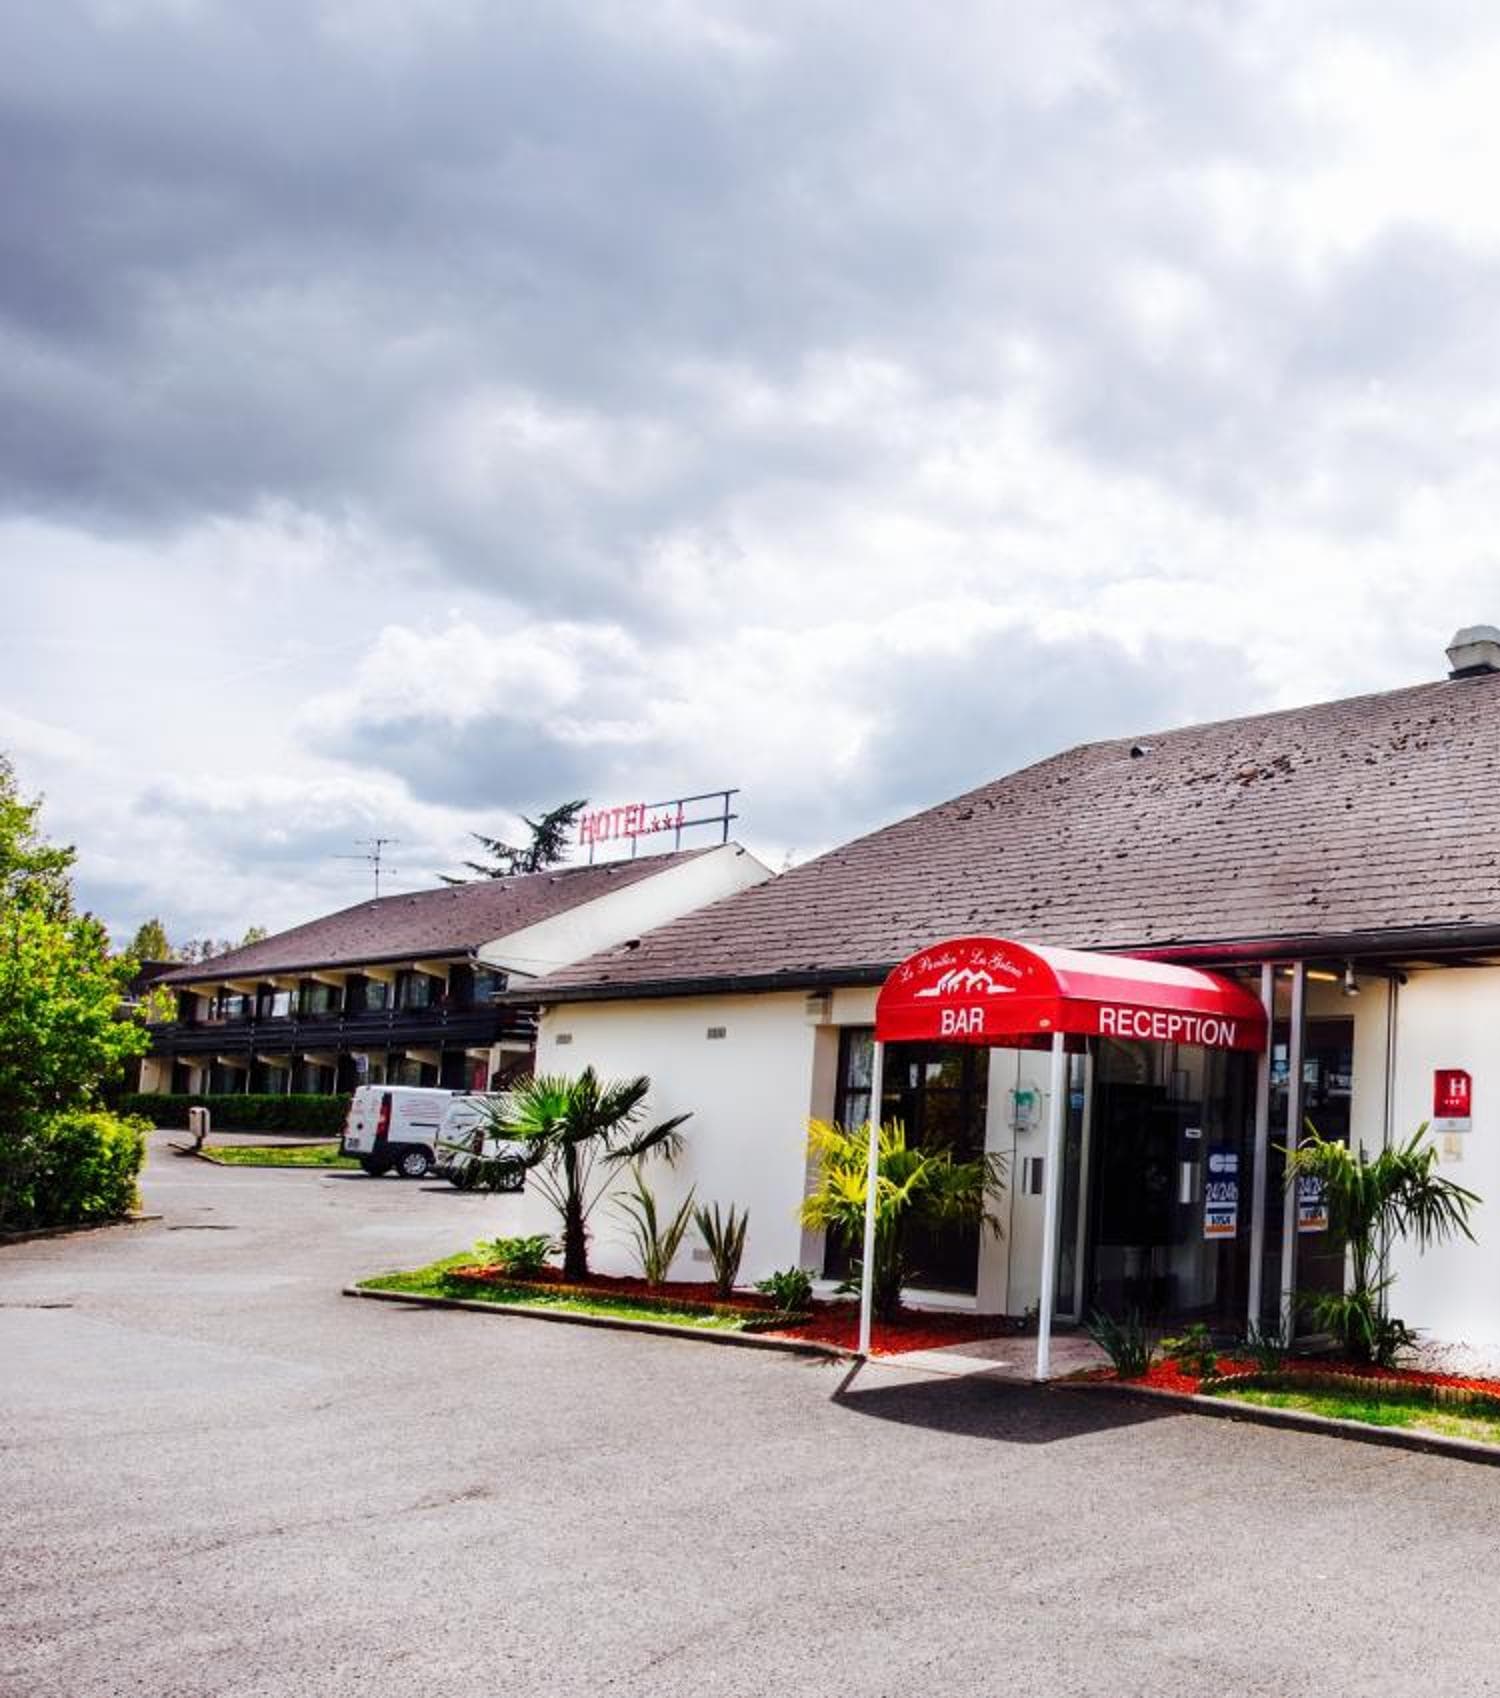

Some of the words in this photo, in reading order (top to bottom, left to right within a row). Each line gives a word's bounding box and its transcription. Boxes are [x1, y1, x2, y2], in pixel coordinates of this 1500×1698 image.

[579, 802, 646, 845] HOTEL
[941, 1007, 984, 1035] BAR
[1099, 1007, 1236, 1046] RECEPTION
[1450, 1078, 1466, 1096] H
